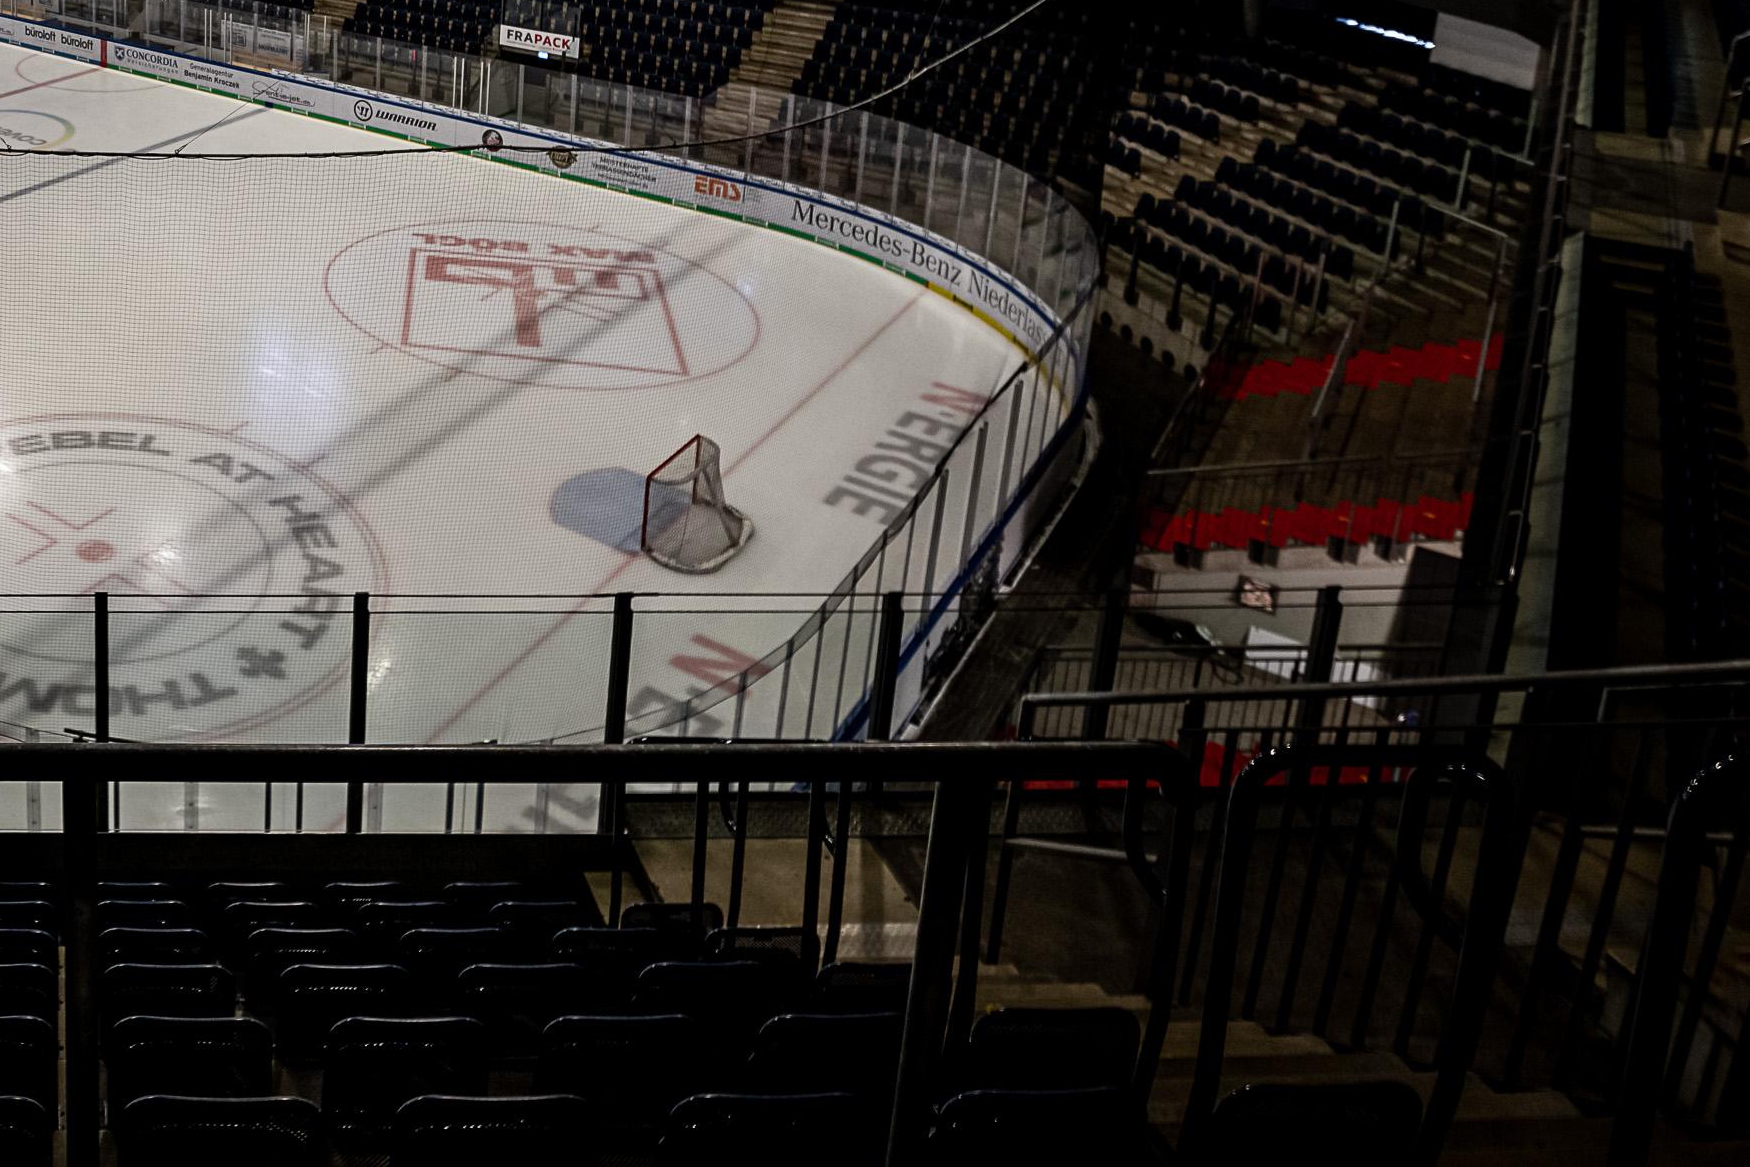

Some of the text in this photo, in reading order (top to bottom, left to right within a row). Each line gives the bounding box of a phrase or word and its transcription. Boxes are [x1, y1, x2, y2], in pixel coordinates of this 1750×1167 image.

[24, 25, 57, 42] büroloft
[60, 33, 94, 51] büroloft
[506, 29, 571, 51] FRAPACK
[126, 48, 179, 69] CONCORDIA
[183, 69, 240, 89] Benjamin Kroczek
[189, 62, 234, 78] Generalagentur
[375, 109, 437, 132] WARRIOR
[790, 199, 1047, 346] Mercedes-Benz Niederlas
[189, 452, 276, 484] AT
[268, 496, 345, 651] HEART
